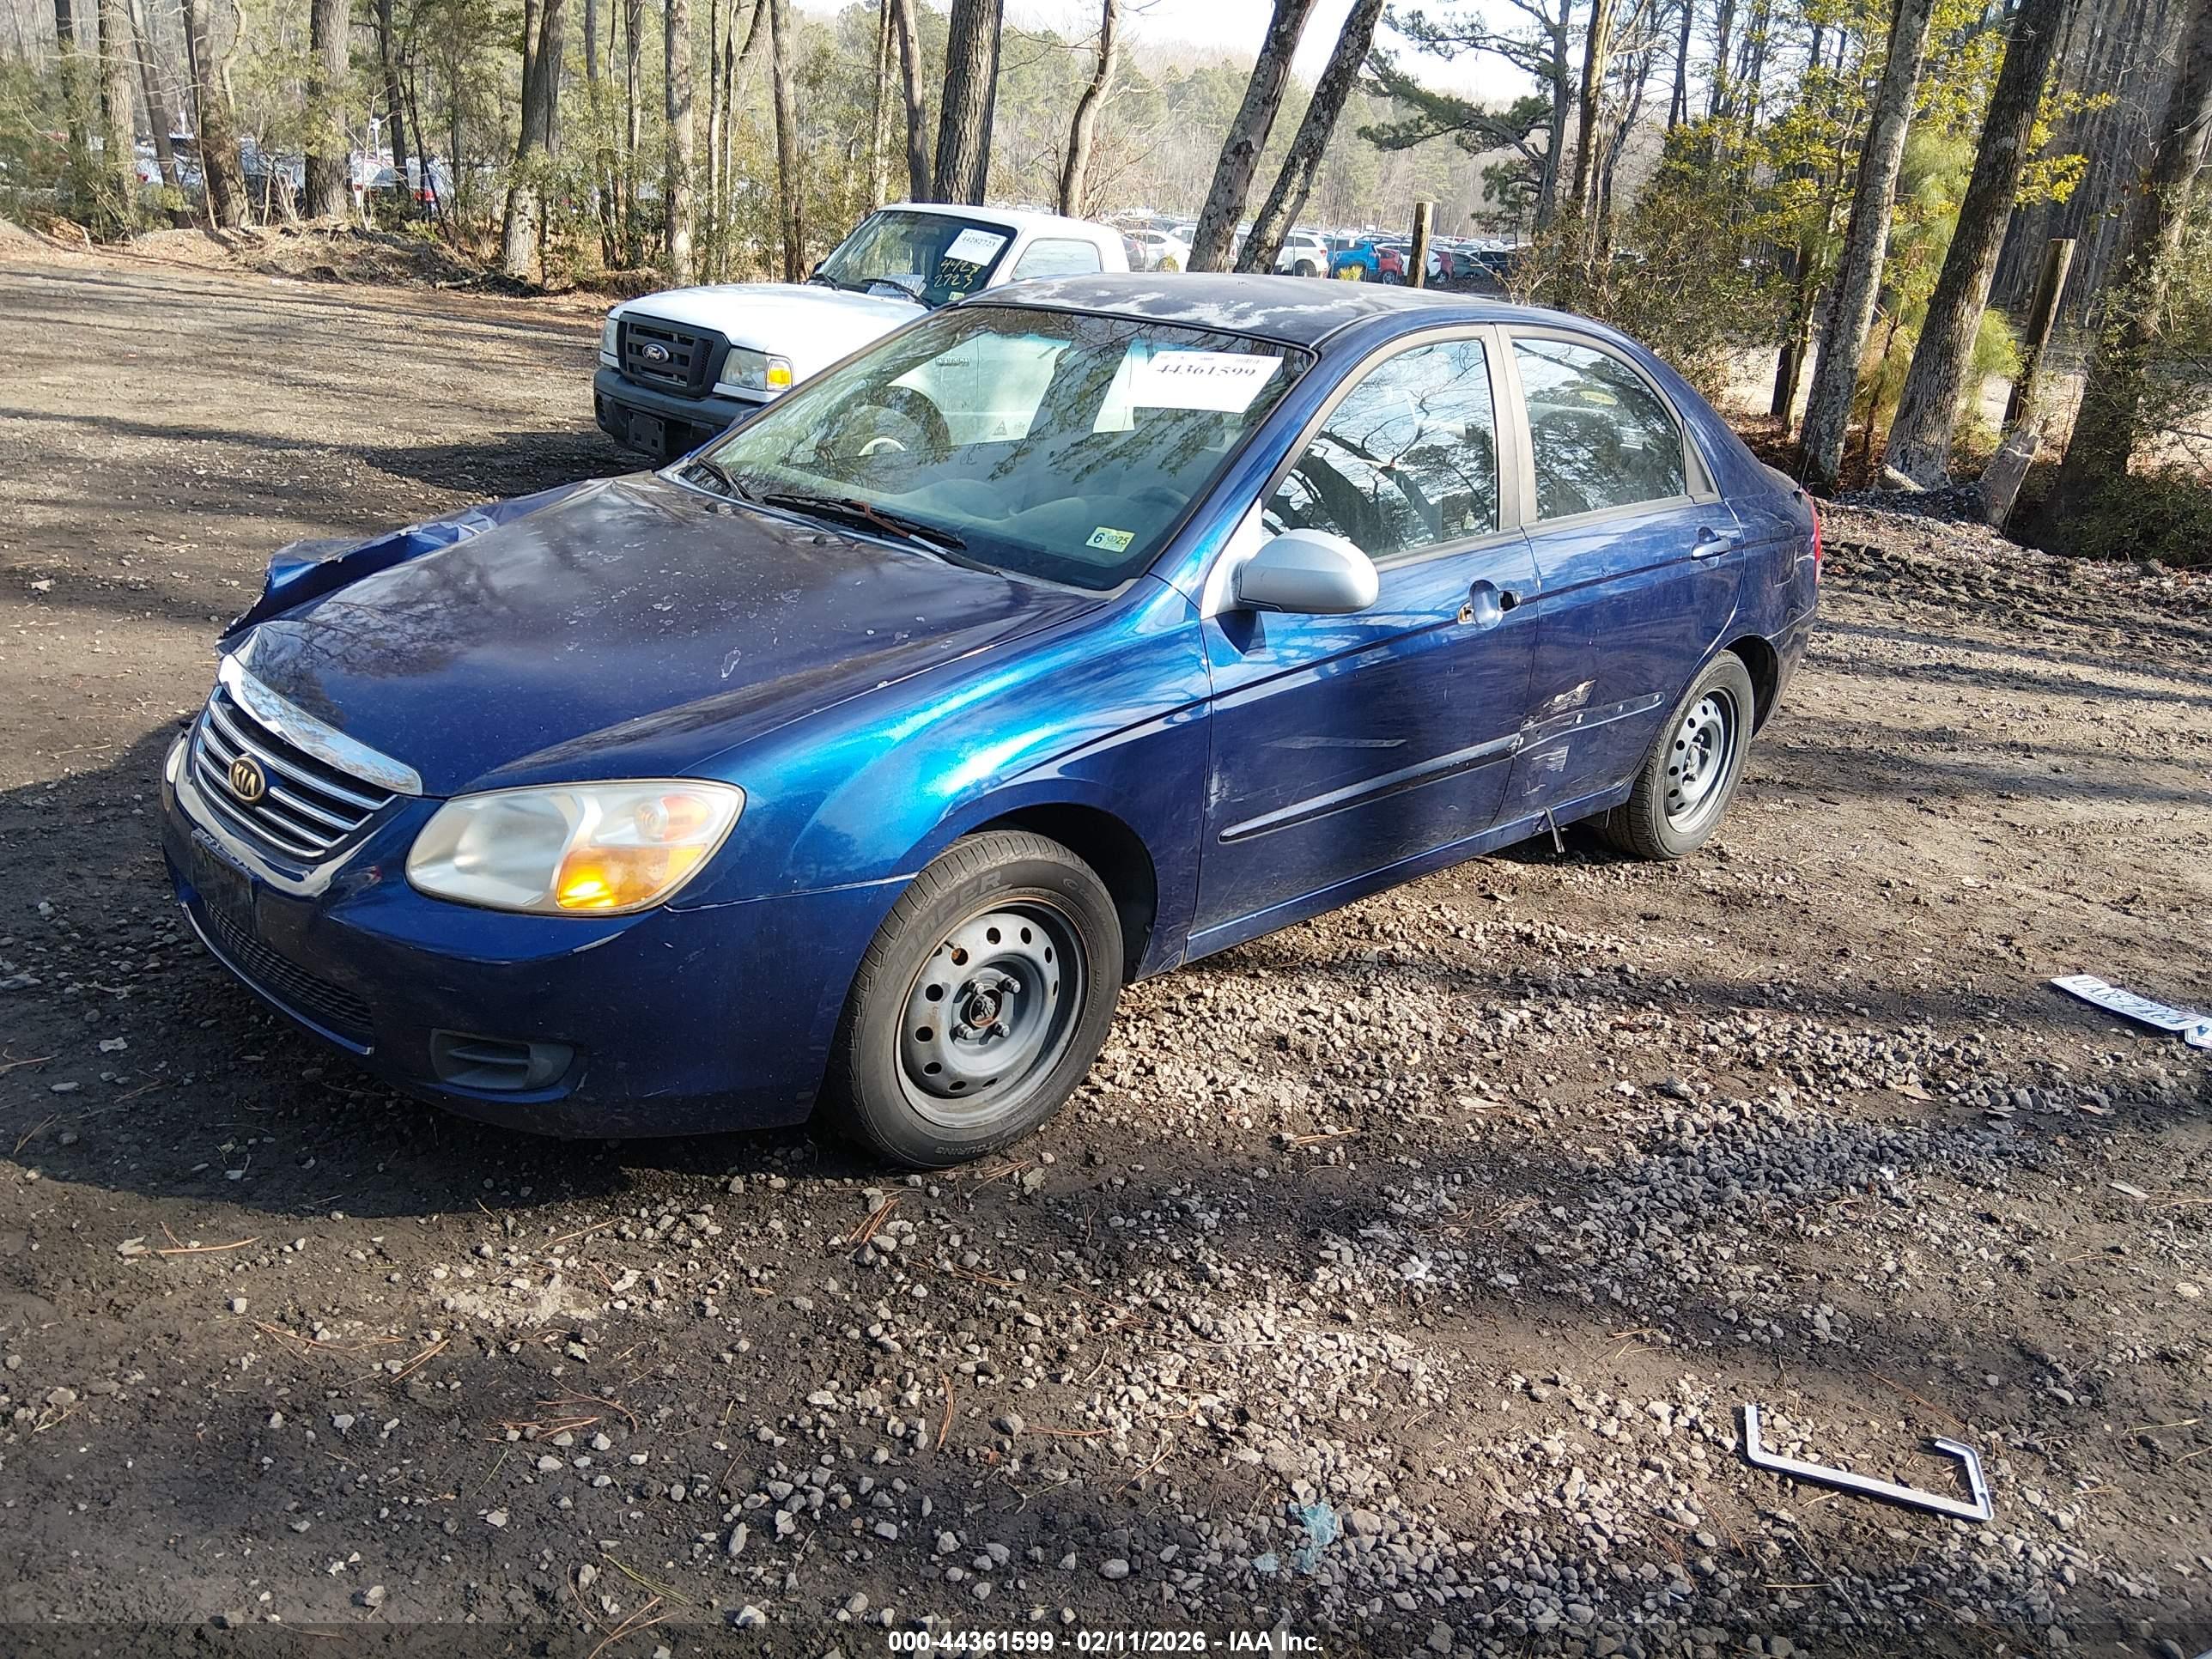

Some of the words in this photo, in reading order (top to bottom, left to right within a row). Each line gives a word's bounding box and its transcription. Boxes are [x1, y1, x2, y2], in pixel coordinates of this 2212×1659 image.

[933, 273, 973, 290] 2723
[1156, 363, 1257, 377] 44361599
[1093, 532, 1105, 544] 6
[1115, 536, 1130, 545] 25
[232, 763, 257, 797] KIA
[2116, 989, 2169, 1013] VIRGINIA
[934, 1141, 994, 1157] TOURING
